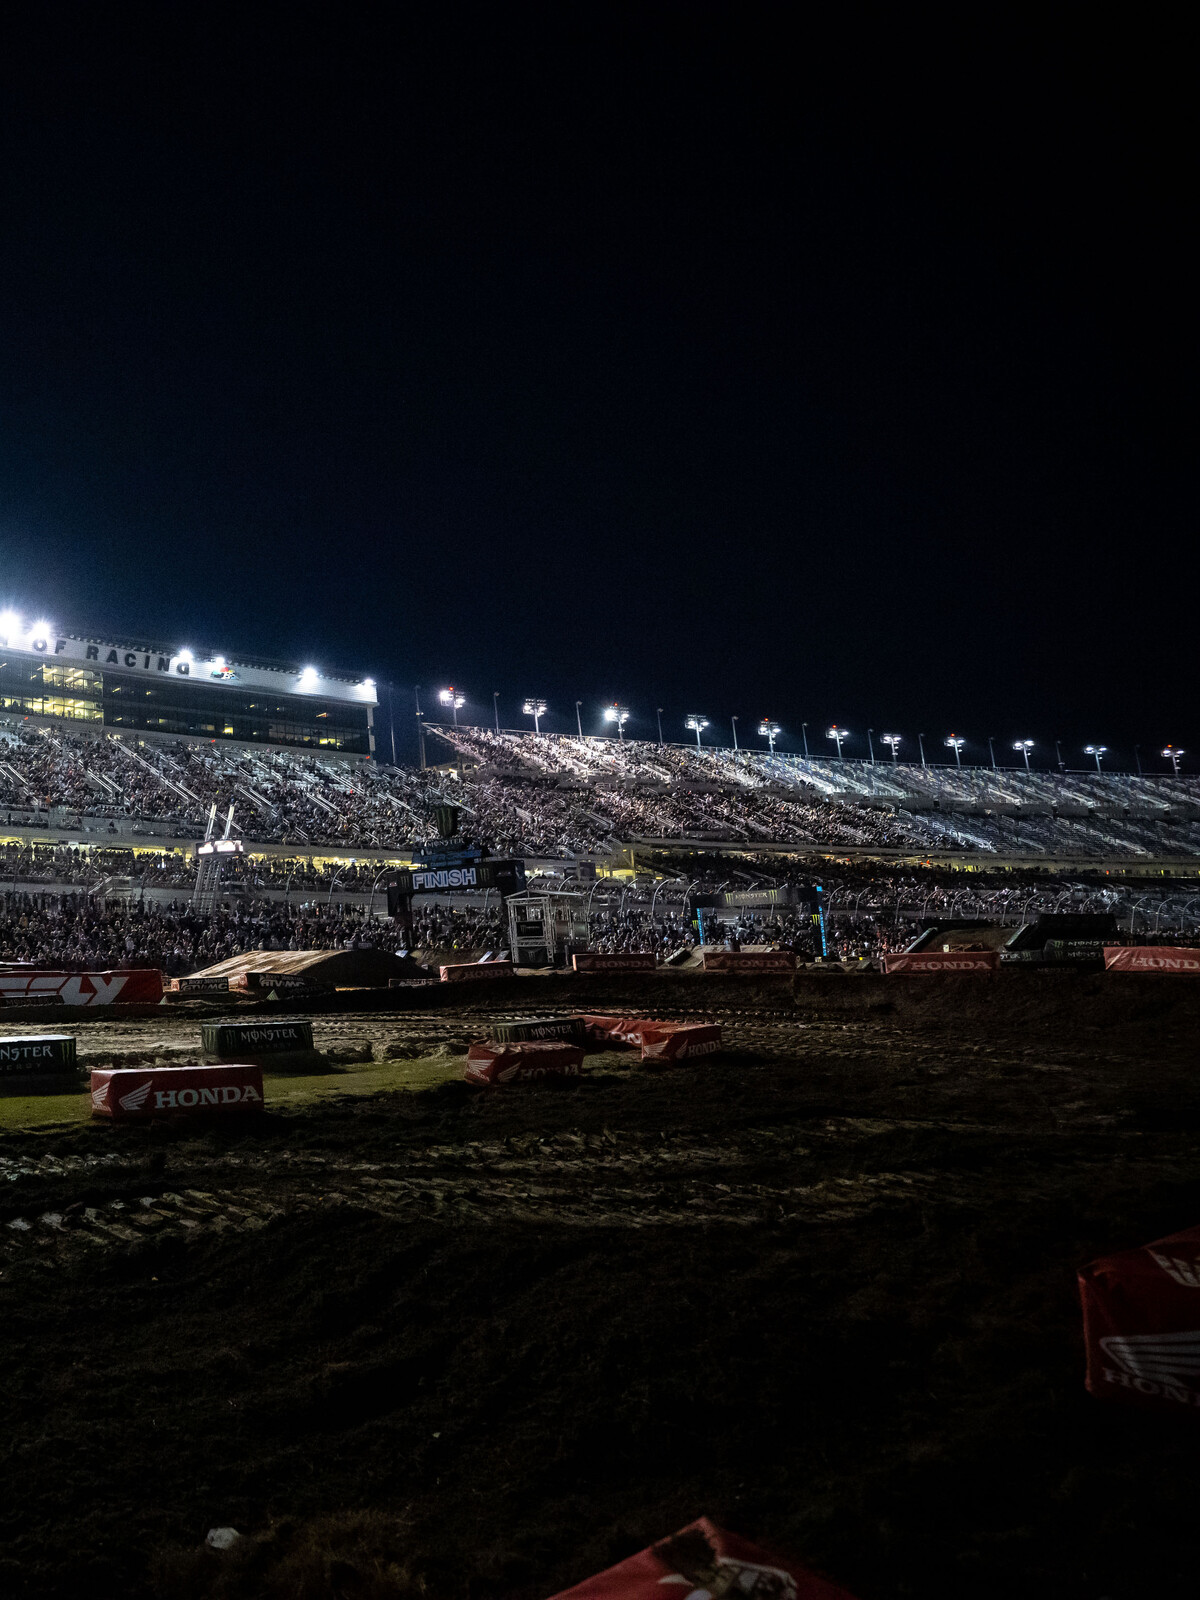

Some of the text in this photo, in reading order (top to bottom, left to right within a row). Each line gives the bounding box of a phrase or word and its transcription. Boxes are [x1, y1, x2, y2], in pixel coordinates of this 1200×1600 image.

[33, 638, 67, 654] OF
[86, 645, 190, 675] RACING
[412, 867, 477, 890] FINISH
[736, 891, 768, 900] MONSTER
[595, 960, 653, 968] HONDA
[726, 959, 793, 968] HONDA
[911, 961, 992, 970] HONDA
[465, 969, 514, 979] HONDA
[241, 1028, 299, 1043] MONSTER
[531, 1024, 575, 1039] MONSTER
[688, 1041, 723, 1058] HONDA
[153, 1085, 263, 1109] HONDA
